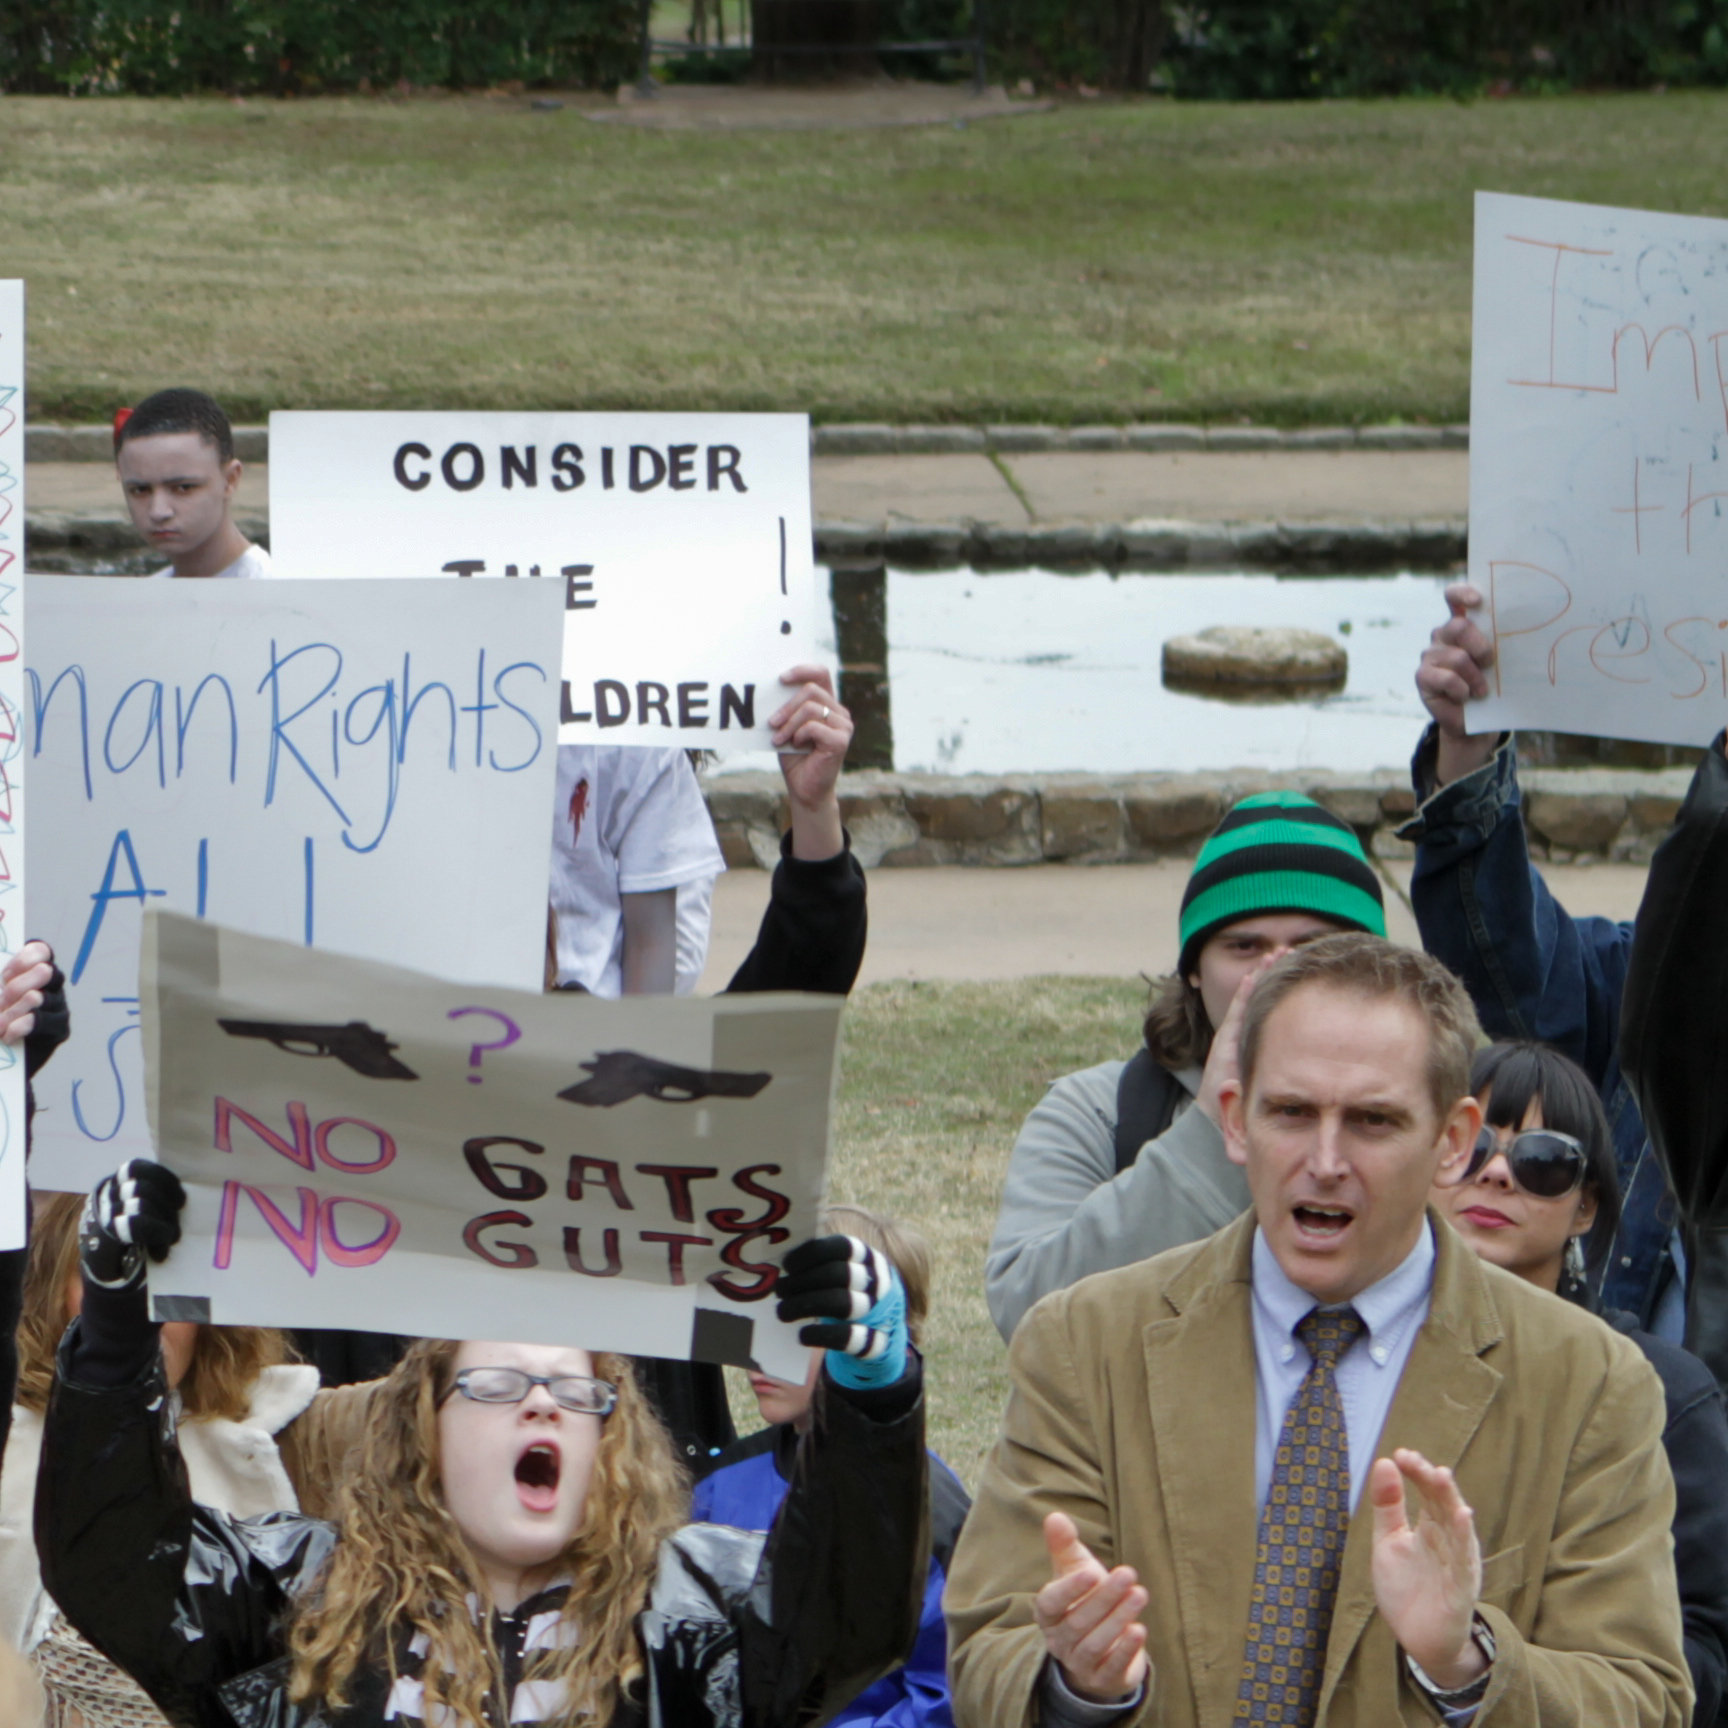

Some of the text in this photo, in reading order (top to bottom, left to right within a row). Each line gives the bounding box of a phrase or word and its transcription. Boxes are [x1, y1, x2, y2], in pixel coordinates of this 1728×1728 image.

[393, 441, 748, 493] CONSIDER
[442, 559, 597, 611] TE
[257, 638, 547, 853] Rights
[448, 1006, 522, 1085] ?
[214, 1095, 791, 1232] NO GATS
[212, 1178, 791, 1302] NO GUTS
